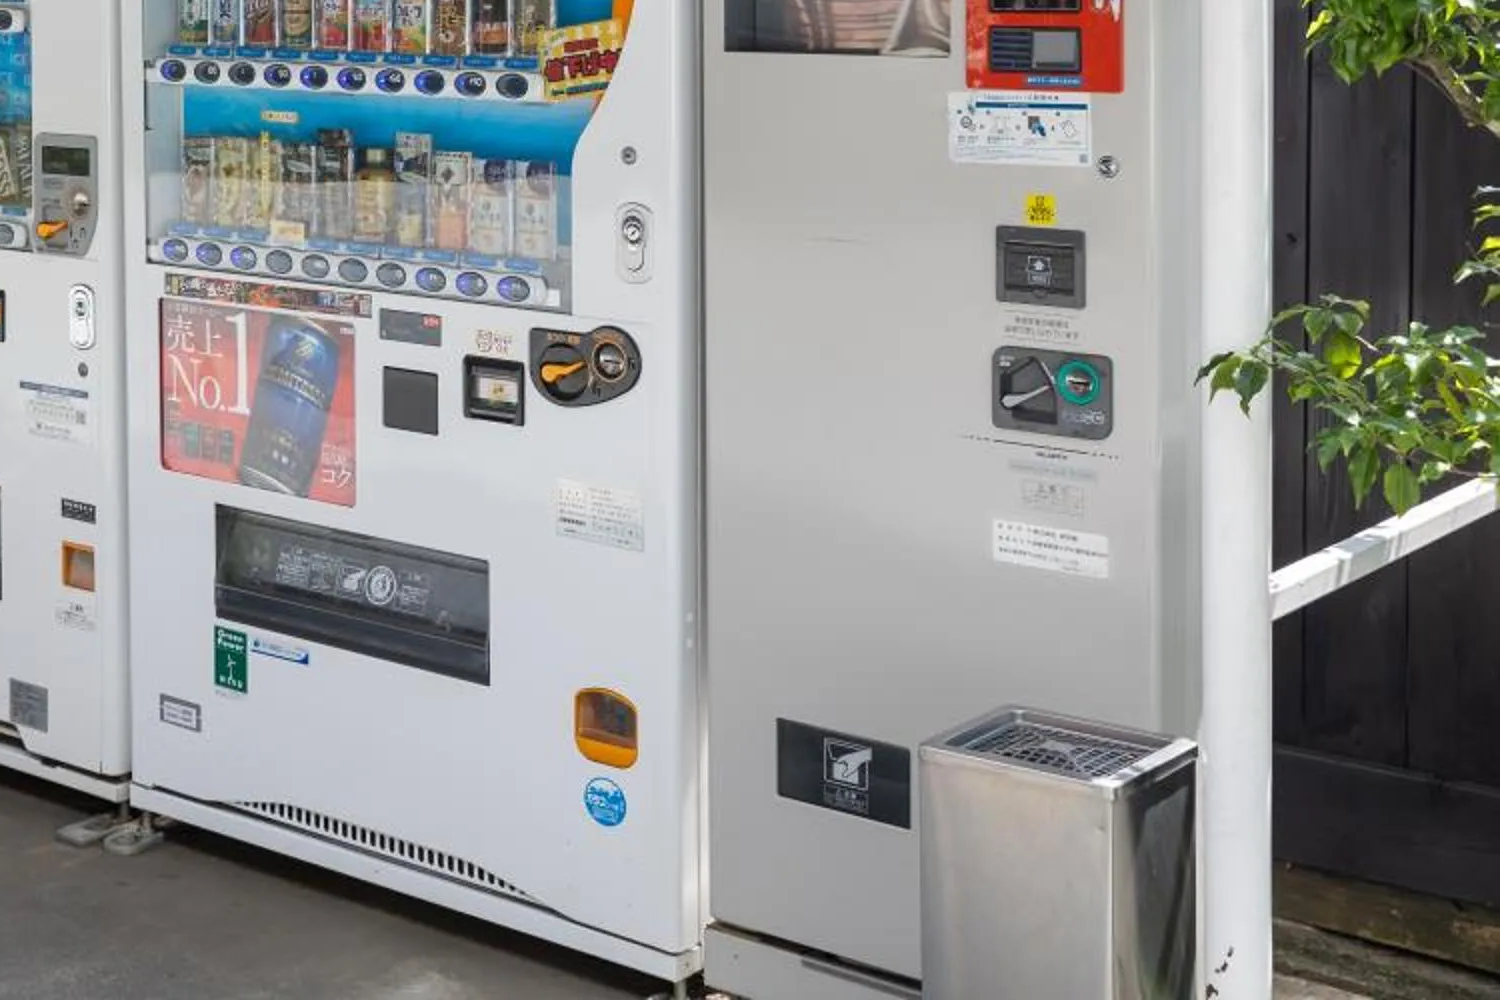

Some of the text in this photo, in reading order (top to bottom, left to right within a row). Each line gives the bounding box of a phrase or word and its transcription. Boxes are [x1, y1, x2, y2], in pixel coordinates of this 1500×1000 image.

[166, 314, 223, 357] 売上
[217, 628, 244, 643] Green
[217, 638, 244, 653] Power
